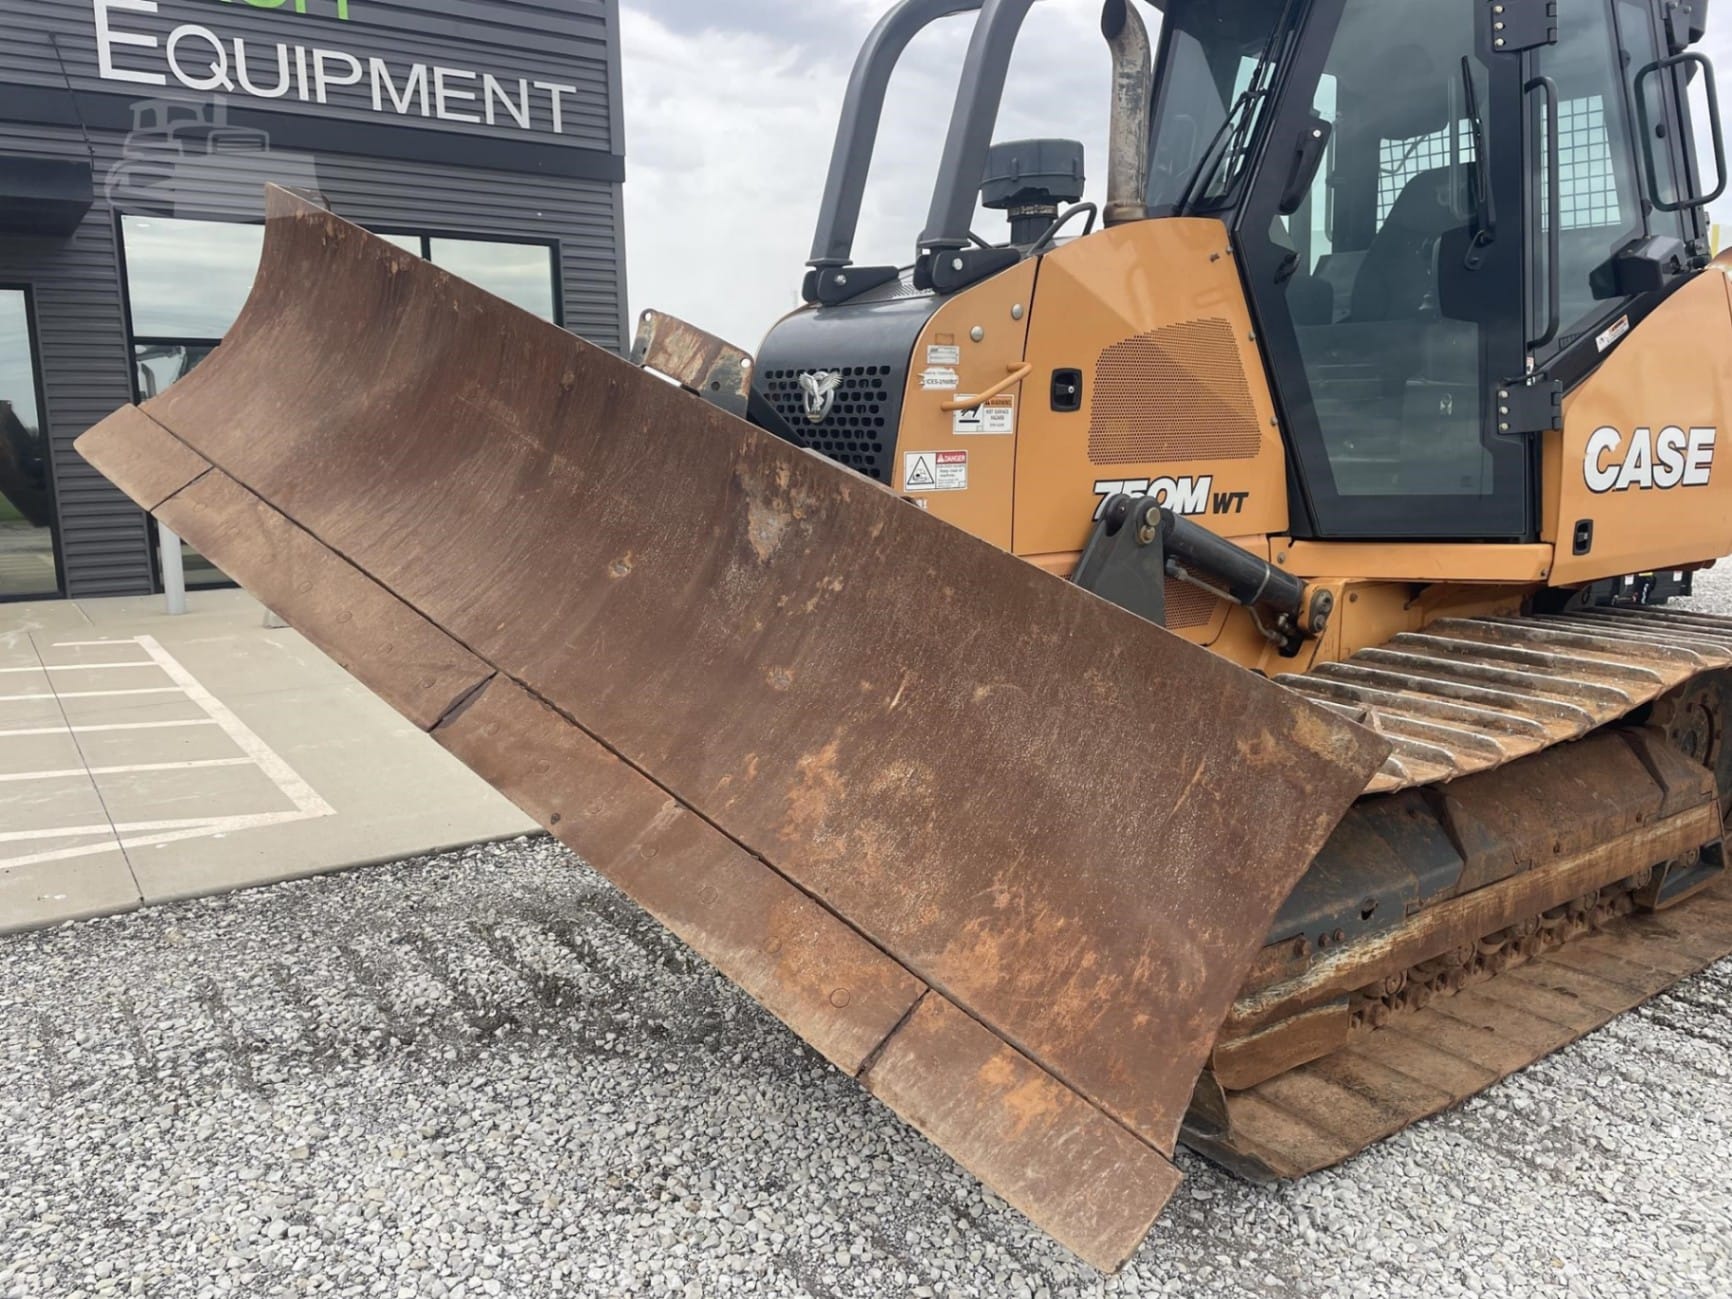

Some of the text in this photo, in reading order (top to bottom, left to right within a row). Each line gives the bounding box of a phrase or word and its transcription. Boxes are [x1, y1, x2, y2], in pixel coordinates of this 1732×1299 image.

[93, 0, 577, 133] EQUIPMENT
[1583, 425, 1717, 494] CASE
[1213, 491, 1249, 515] WT
